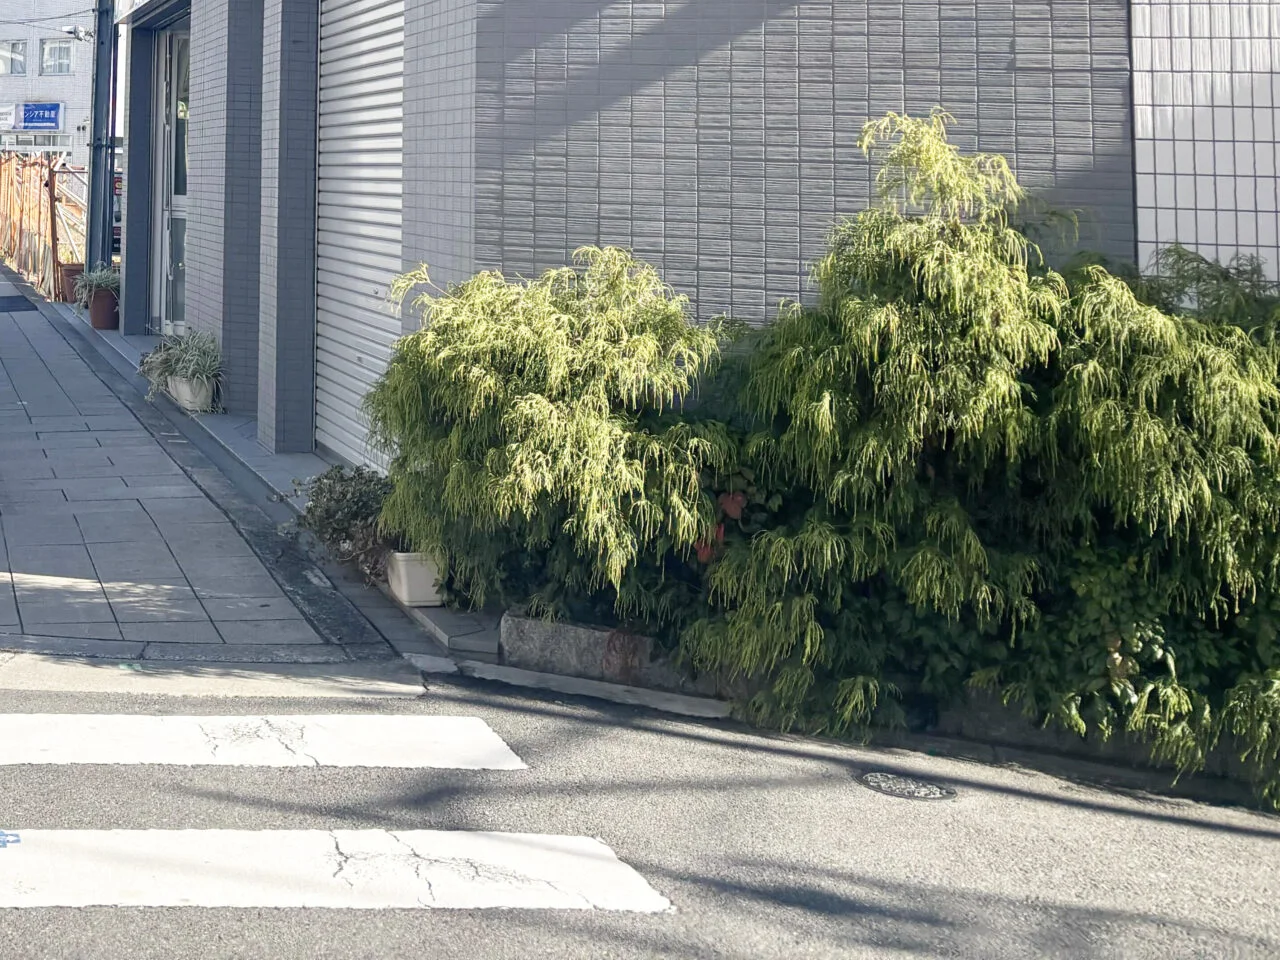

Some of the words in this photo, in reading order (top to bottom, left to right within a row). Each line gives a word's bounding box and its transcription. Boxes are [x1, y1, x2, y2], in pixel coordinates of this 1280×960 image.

[20, 110, 56, 118] ンシア不動産
